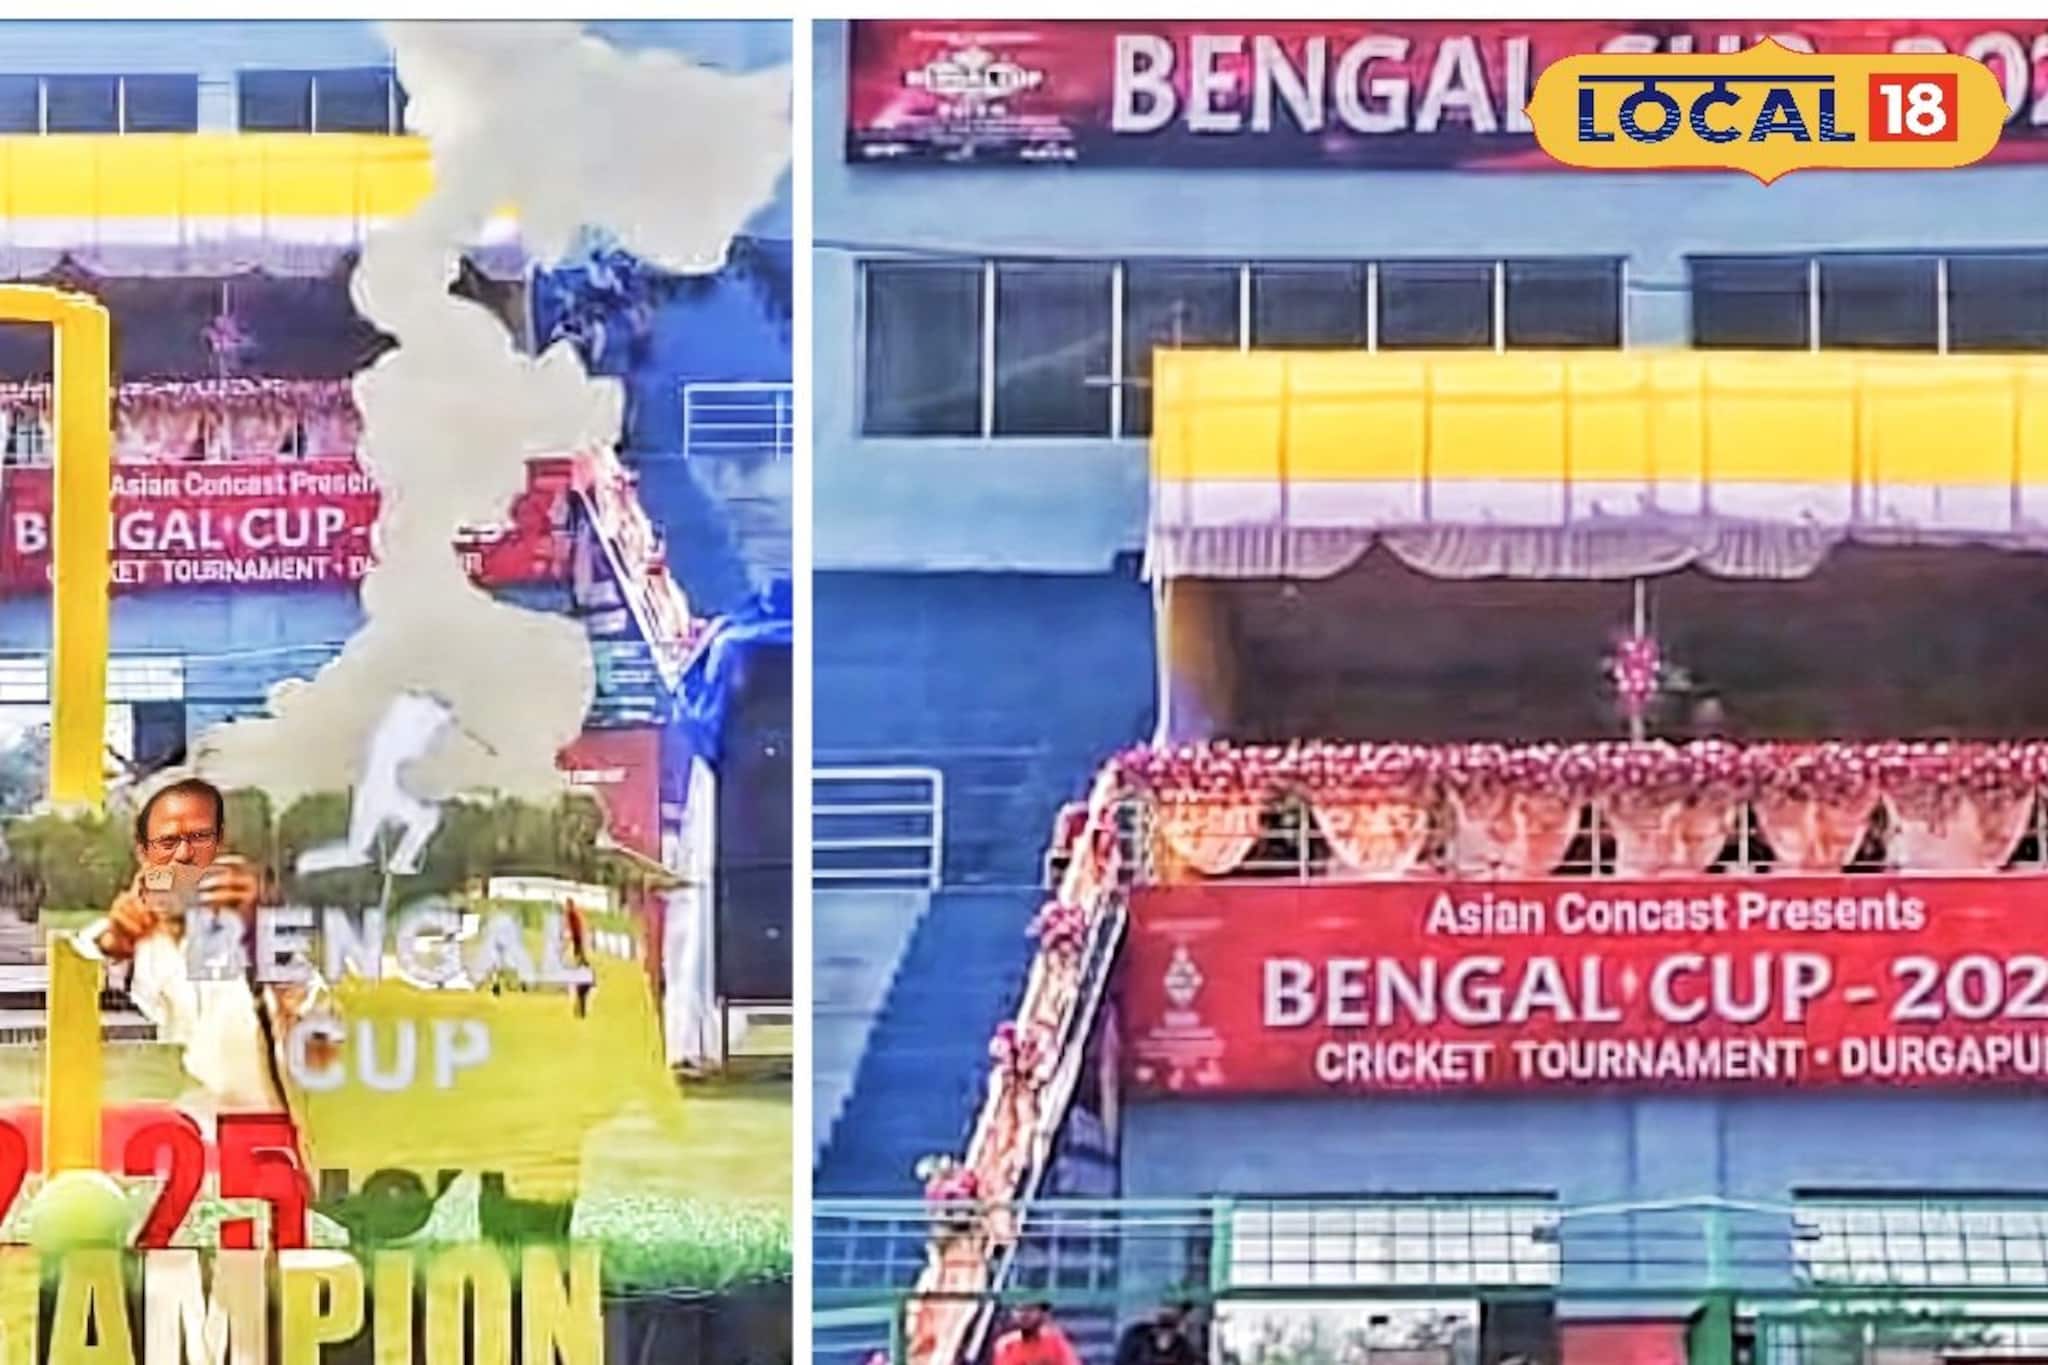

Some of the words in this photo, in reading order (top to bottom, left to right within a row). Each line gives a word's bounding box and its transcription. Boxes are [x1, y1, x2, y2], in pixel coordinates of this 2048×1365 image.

[1112, 34, 1536, 134] BENGAL
[111, 473, 179, 497] Asian
[184, 471, 288, 497] Concast
[13, 509, 223, 553] BGAL
[239, 507, 346, 549] CUP
[183, 900, 597, 986] BENGAL
[1426, 891, 1545, 935] Asian
[1555, 891, 1727, 935] Concast
[1737, 890, 1927, 932] Presents
[1263, 955, 1623, 1027] BENGAL
[1649, 953, 1832, 1024] CUP
[286, 1012, 493, 1093] CUP
[1315, 1039, 1496, 1082] CRICKET
[1511, 1036, 1807, 1080] TOURNAMENT
[1840, 1033, 2048, 1076] DURGAPU
